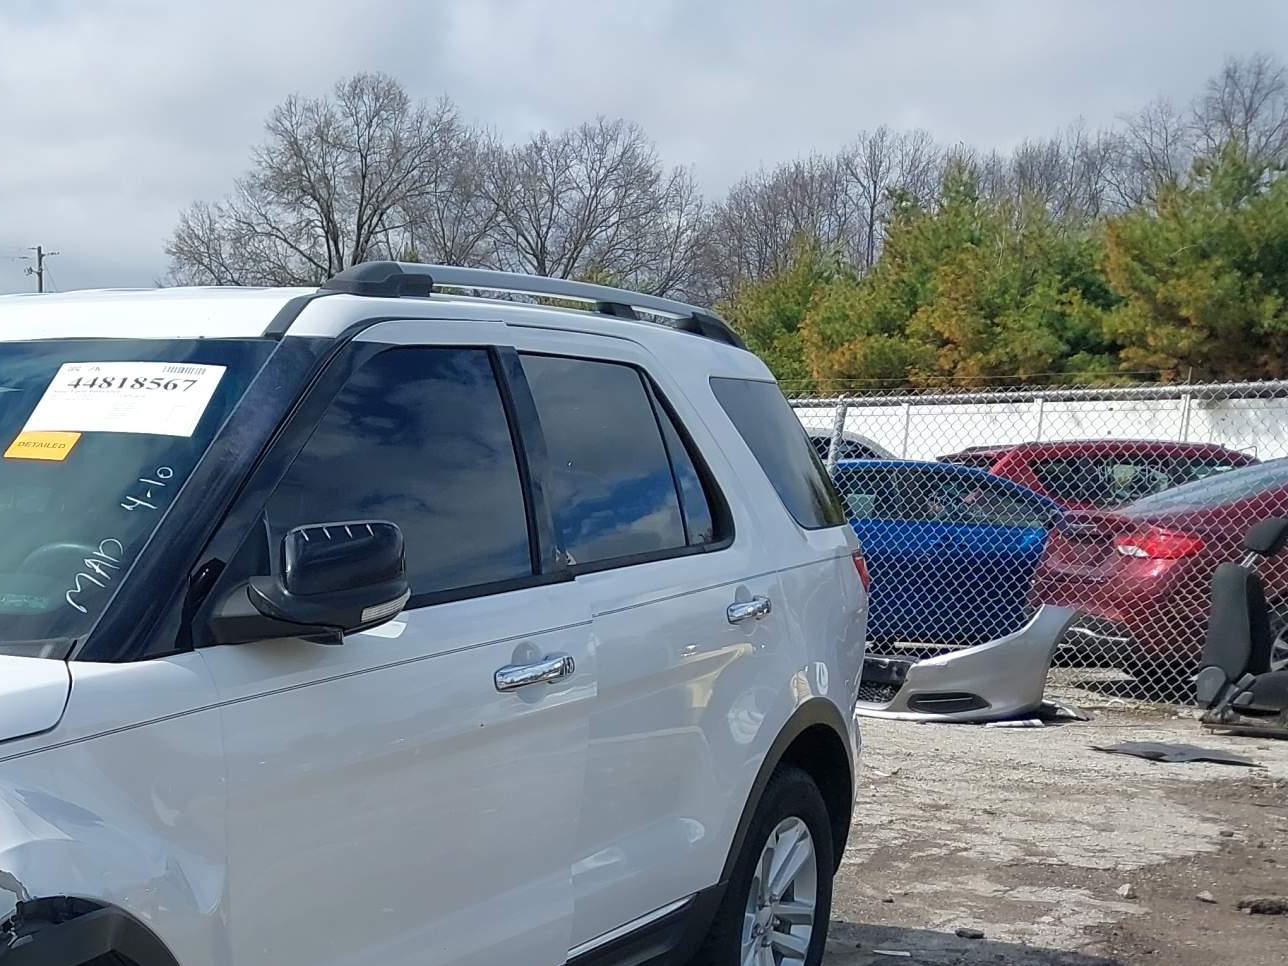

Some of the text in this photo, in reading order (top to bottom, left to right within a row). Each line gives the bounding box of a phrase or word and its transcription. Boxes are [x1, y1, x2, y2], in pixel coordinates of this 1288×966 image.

[67, 376, 198, 392] 44818567
[16, 440, 66, 450] DETAILED
[120, 466, 174, 510] 4-10
